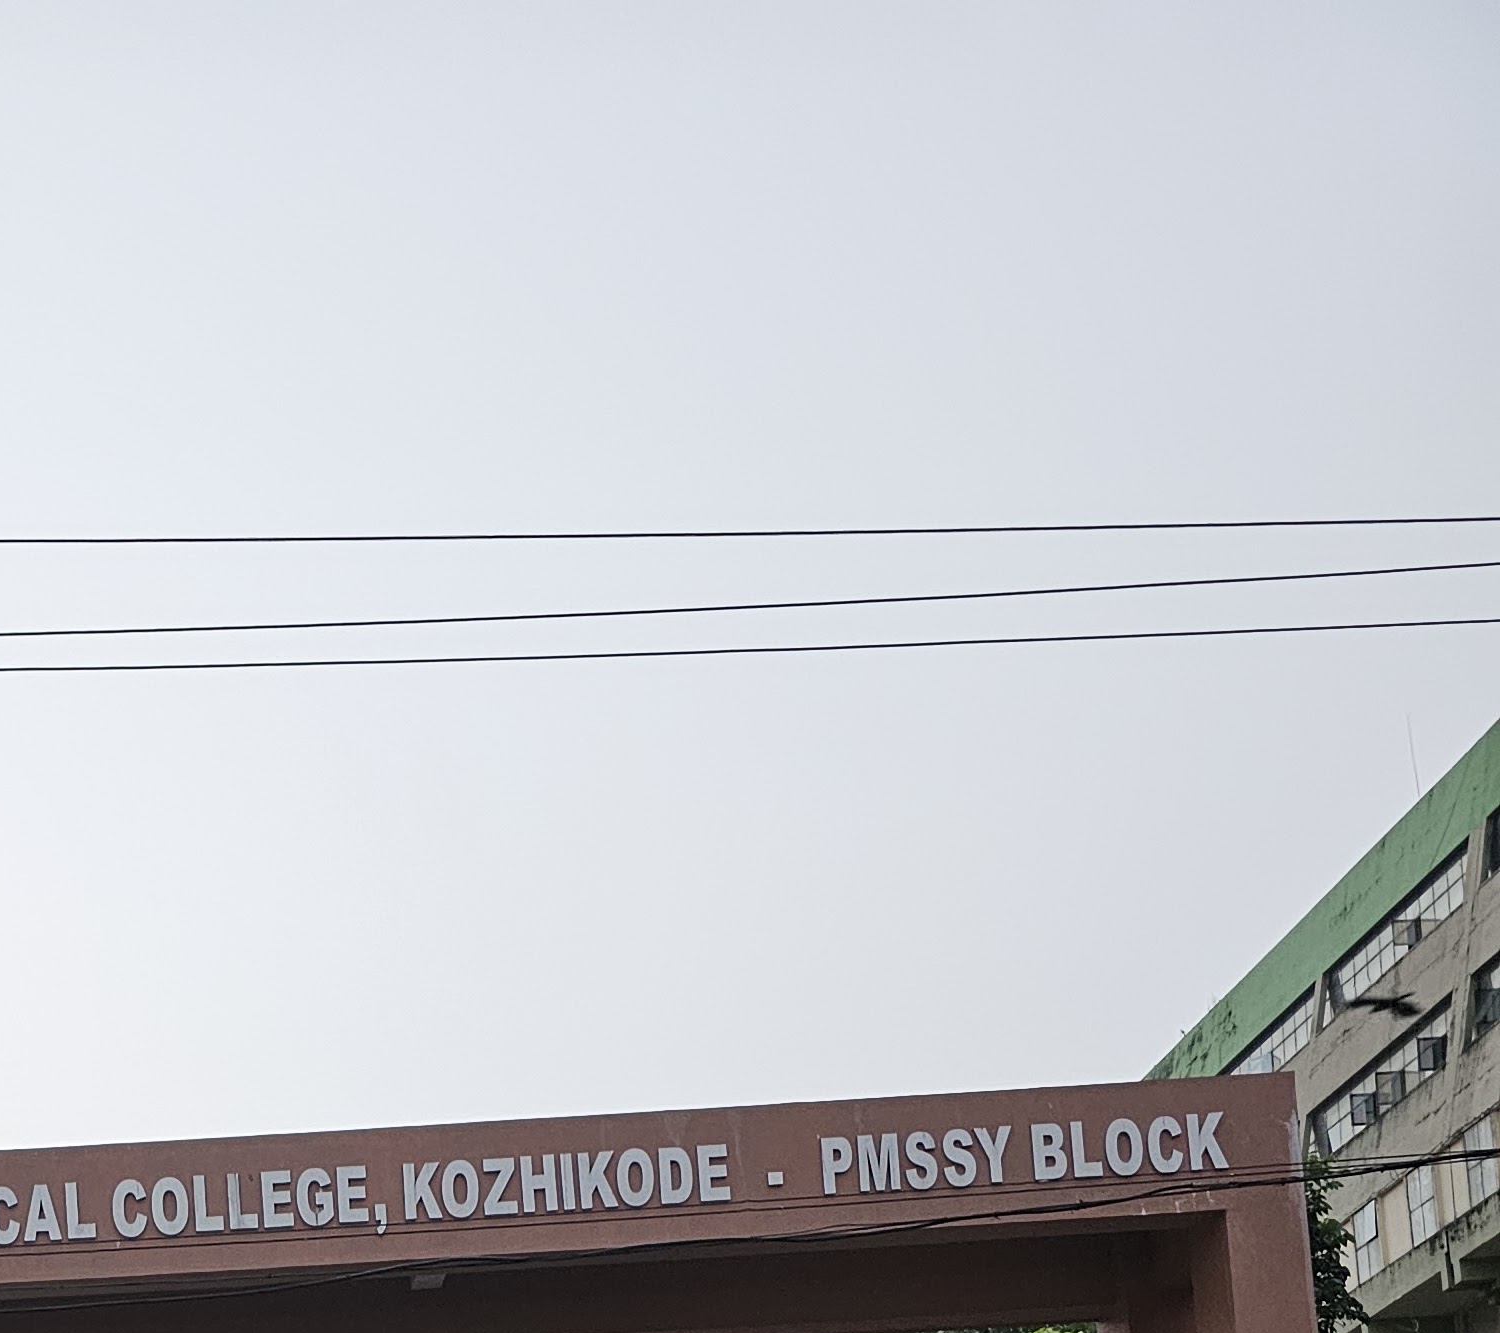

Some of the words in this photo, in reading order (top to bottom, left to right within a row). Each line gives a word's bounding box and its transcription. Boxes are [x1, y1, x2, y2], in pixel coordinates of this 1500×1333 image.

[112, 1165, 387, 1239] COLLEGE,
[402, 1144, 731, 1222] KOZHIKODE
[820, 1125, 1011, 1196] PMSSY
[1030, 1112, 1229, 1182] BLOCK
